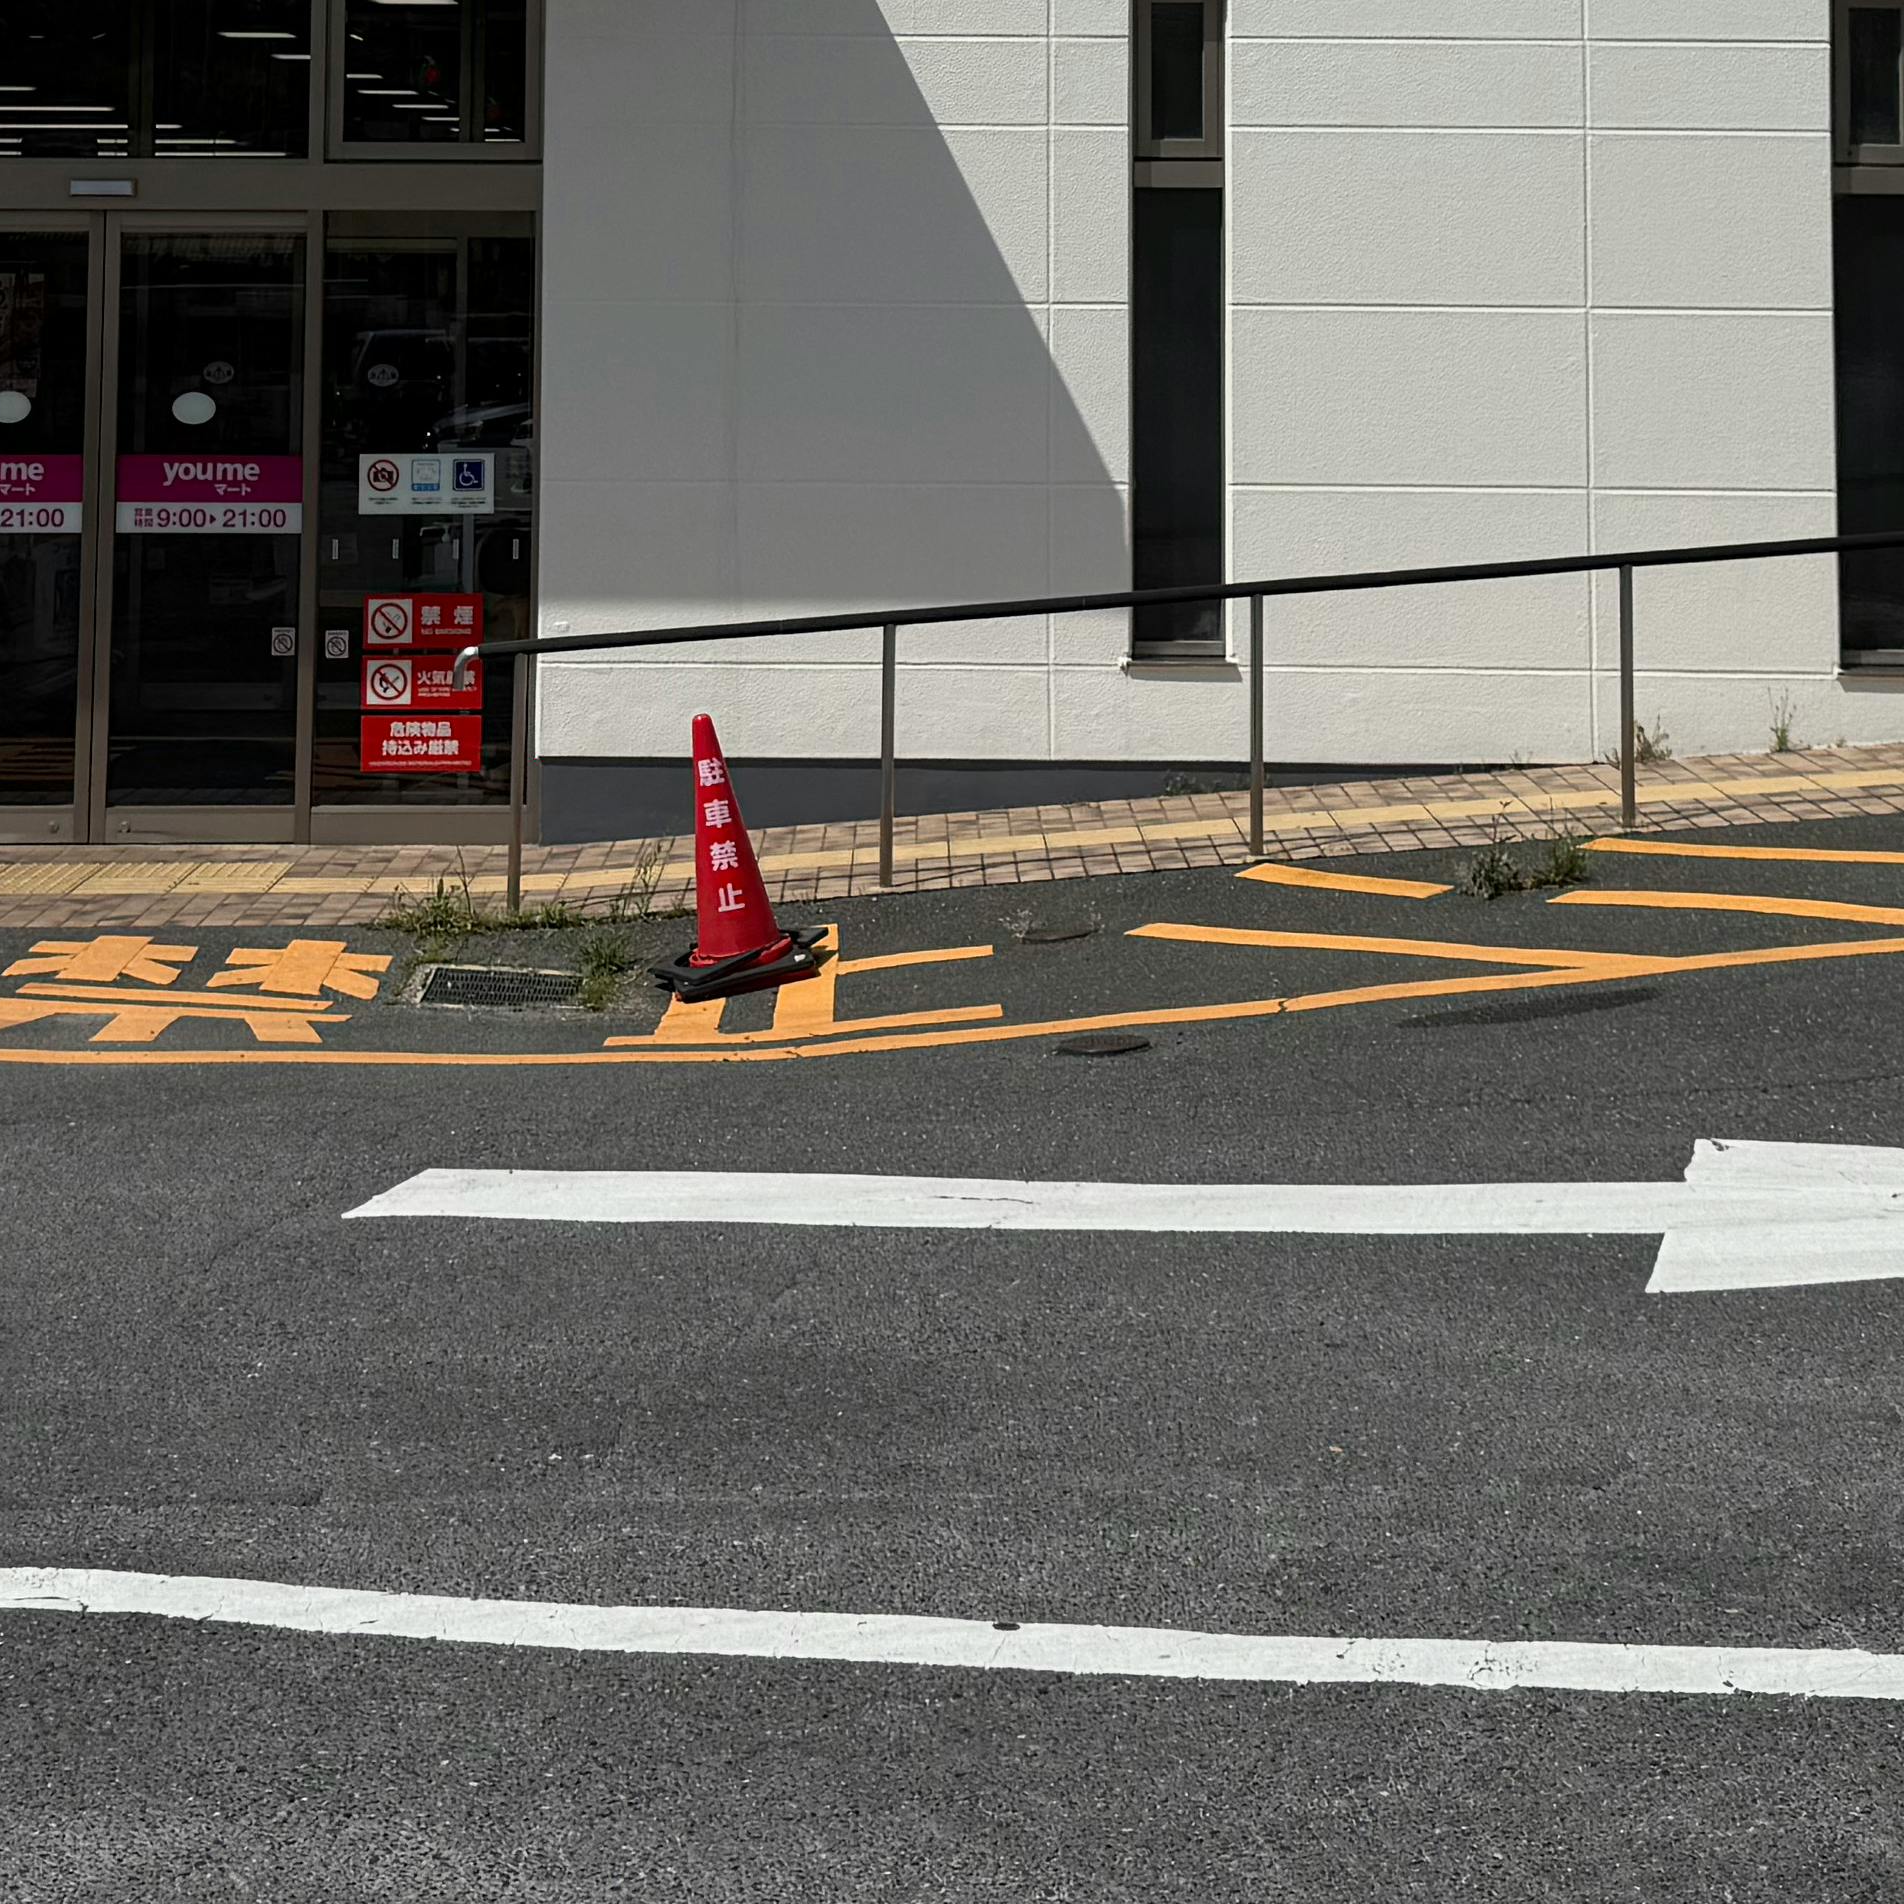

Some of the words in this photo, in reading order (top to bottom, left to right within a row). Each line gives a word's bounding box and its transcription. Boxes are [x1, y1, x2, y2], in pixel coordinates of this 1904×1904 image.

[162, 462, 261, 487] youme
[214, 483, 252, 496] マート
[0, 508, 65, 528] 21:00
[157, 508, 206, 528] 9:00
[223, 508, 286, 528] 21:00
[697, 757, 746, 915] 駐車禁止
